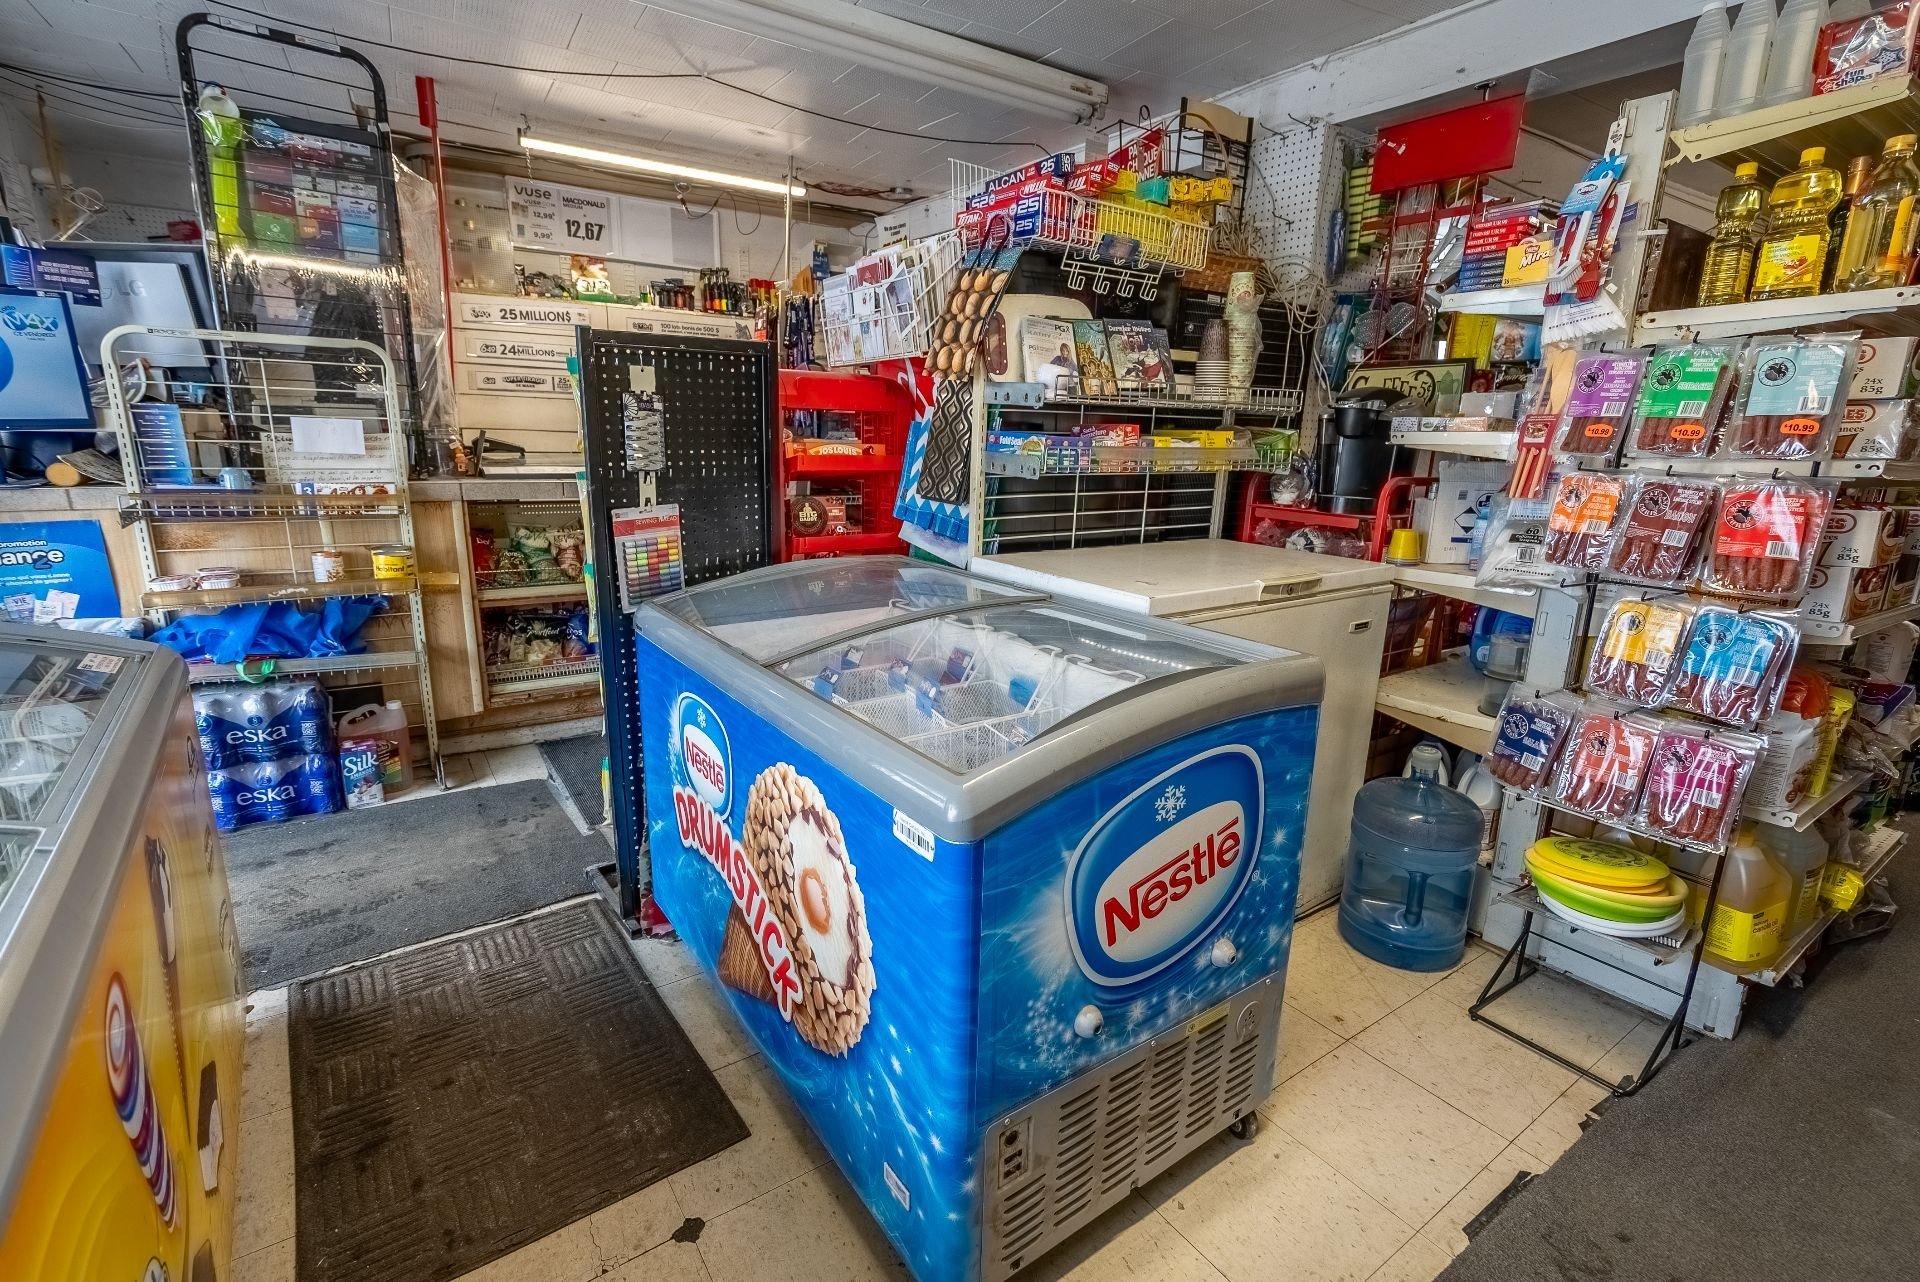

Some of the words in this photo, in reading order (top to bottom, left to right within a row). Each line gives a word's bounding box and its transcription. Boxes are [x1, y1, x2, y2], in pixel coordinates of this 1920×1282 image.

[1835, 73, 1873, 87] shapes
[1845, 69, 1864, 78] fun
[988, 170, 1025, 192] ALCAN
[514, 185, 551, 199] vuse
[562, 196, 605, 209] MACDONALD
[115, 280, 147, 297] LG
[2, 312, 58, 332] MAX
[500, 308, 518, 320] 25
[520, 309, 571, 323] MILLION$
[500, 344, 517, 355] 24
[1860, 385, 1883, 395] 85g
[1784, 424, 1815, 432] $10.99
[1837, 553, 1860, 563] 85g
[1812, 601, 1829, 609] 24x
[1809, 608, 1831, 618] 85g
[226, 725, 288, 745] eska
[344, 752, 379, 776] Silk
[686, 736, 725, 794] Nestlé
[236, 785, 296, 805] eska
[1104, 816, 1240, 947] Nestlé
[676, 791, 799, 1013] DRUMSTICK
